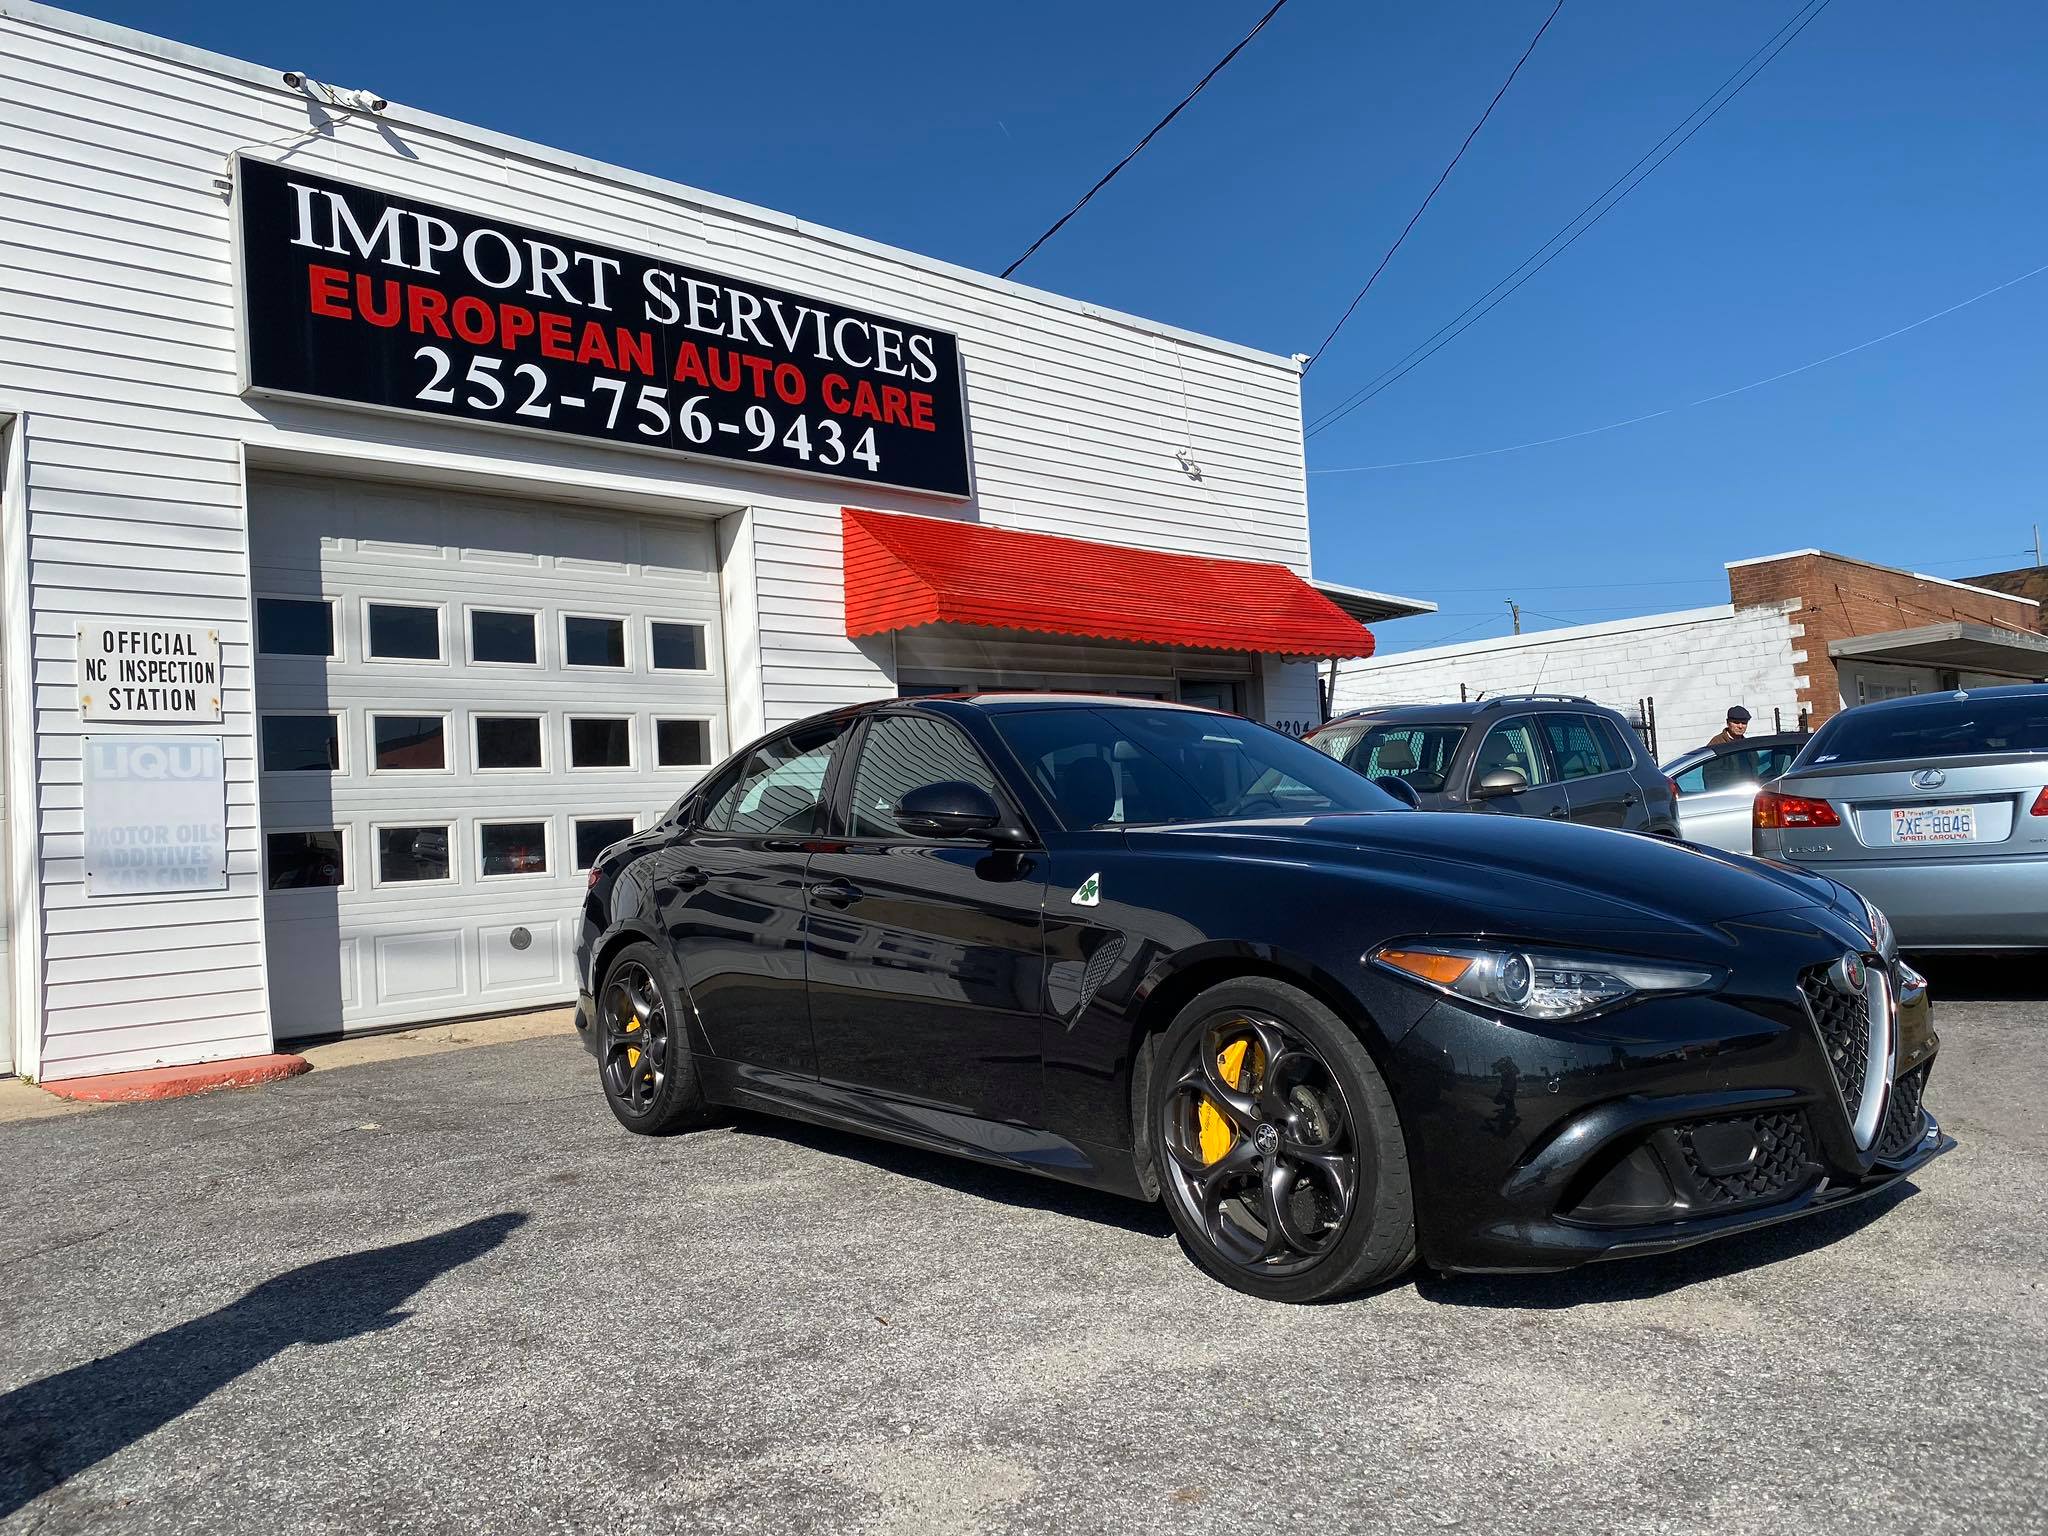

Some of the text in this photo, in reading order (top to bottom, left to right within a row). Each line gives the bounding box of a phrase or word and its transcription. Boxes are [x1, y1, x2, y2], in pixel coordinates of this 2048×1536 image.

[287, 183, 937, 383] IMPORT SERVICES
[308, 264, 936, 432] EUROPEAN AUTO CARE
[413, 346, 881, 473] 252-756-9434
[103, 630, 197, 656] OFFICIAL
[86, 658, 215, 684] NC INSPECTION
[109, 687, 196, 711] STATION
[92, 745, 215, 779] LIQUI
[89, 823, 222, 846] MOTOR OILS
[1896, 815, 1970, 835] ZXE-8846
[100, 846, 213, 868] ADDITIVES
